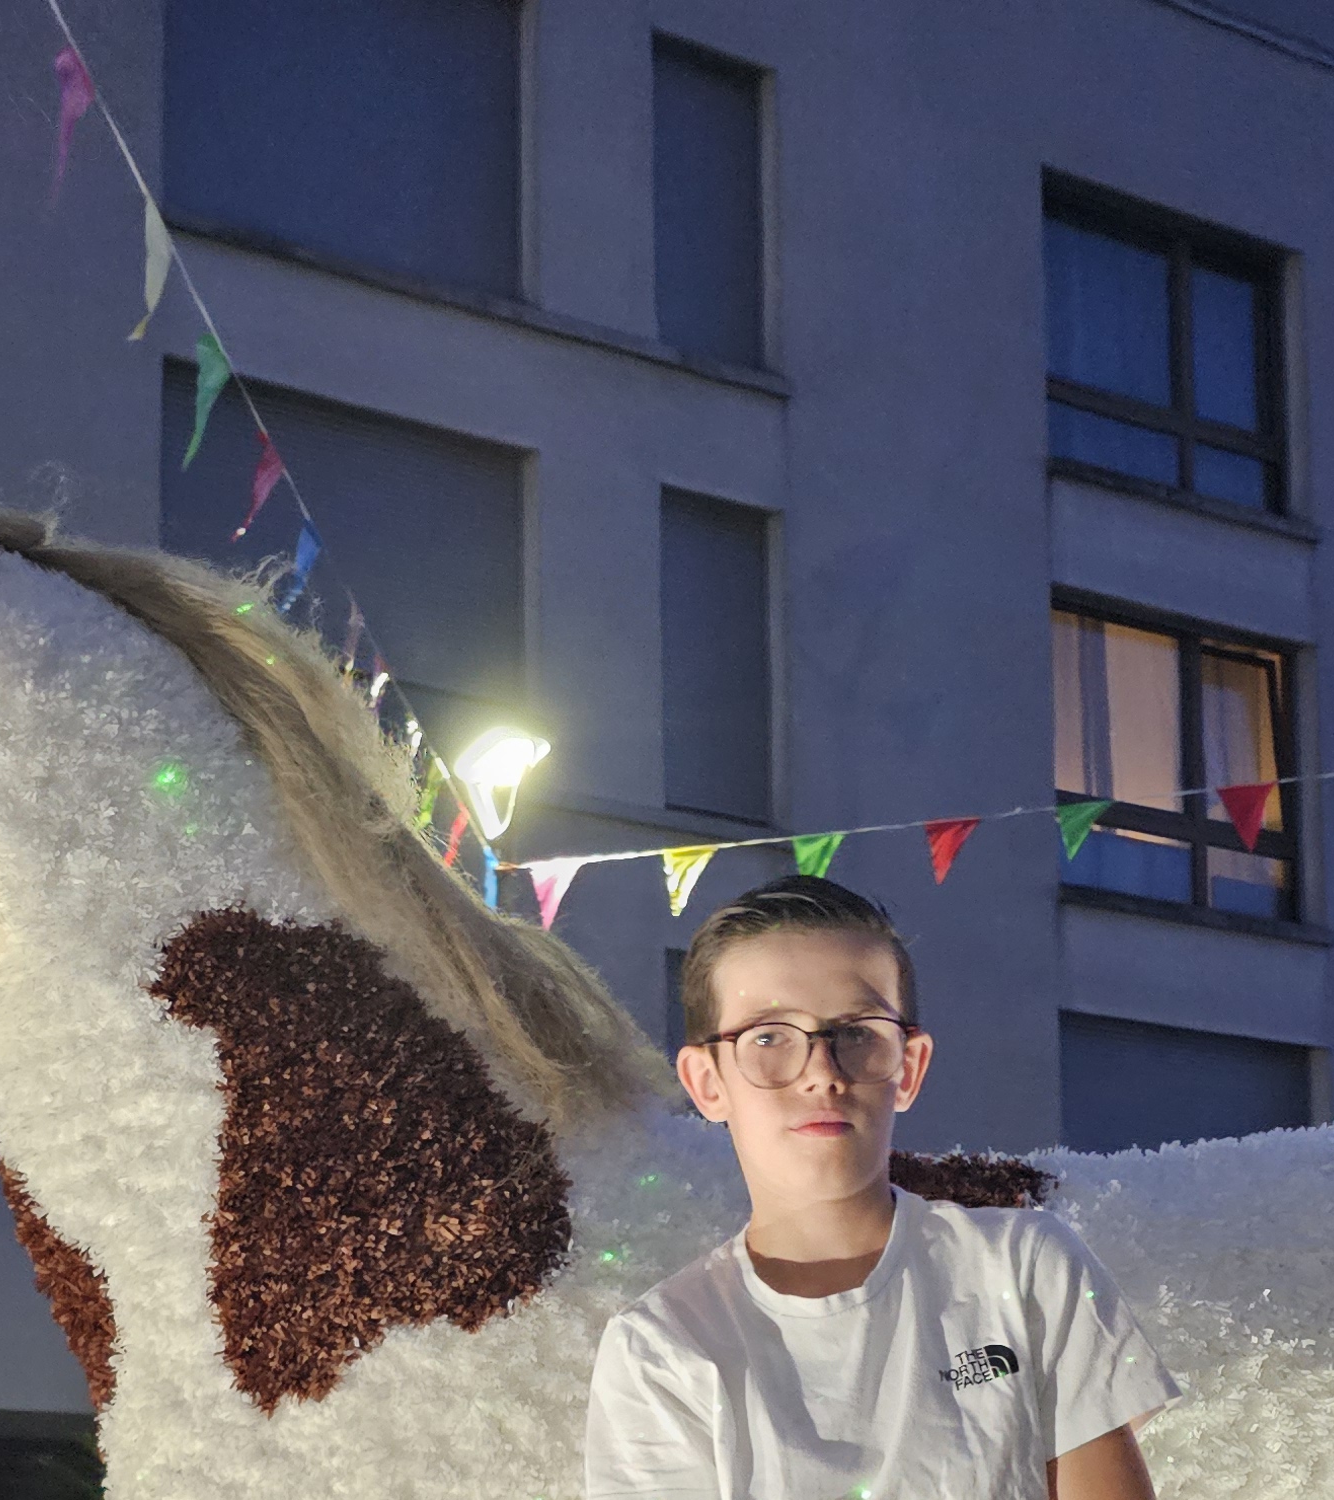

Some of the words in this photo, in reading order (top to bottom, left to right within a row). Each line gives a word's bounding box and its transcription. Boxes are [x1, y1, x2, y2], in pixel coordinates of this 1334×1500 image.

[954, 1347, 985, 1364] THE
[938, 1359, 989, 1382] NORTH
[954, 1371, 993, 1391] FACE
